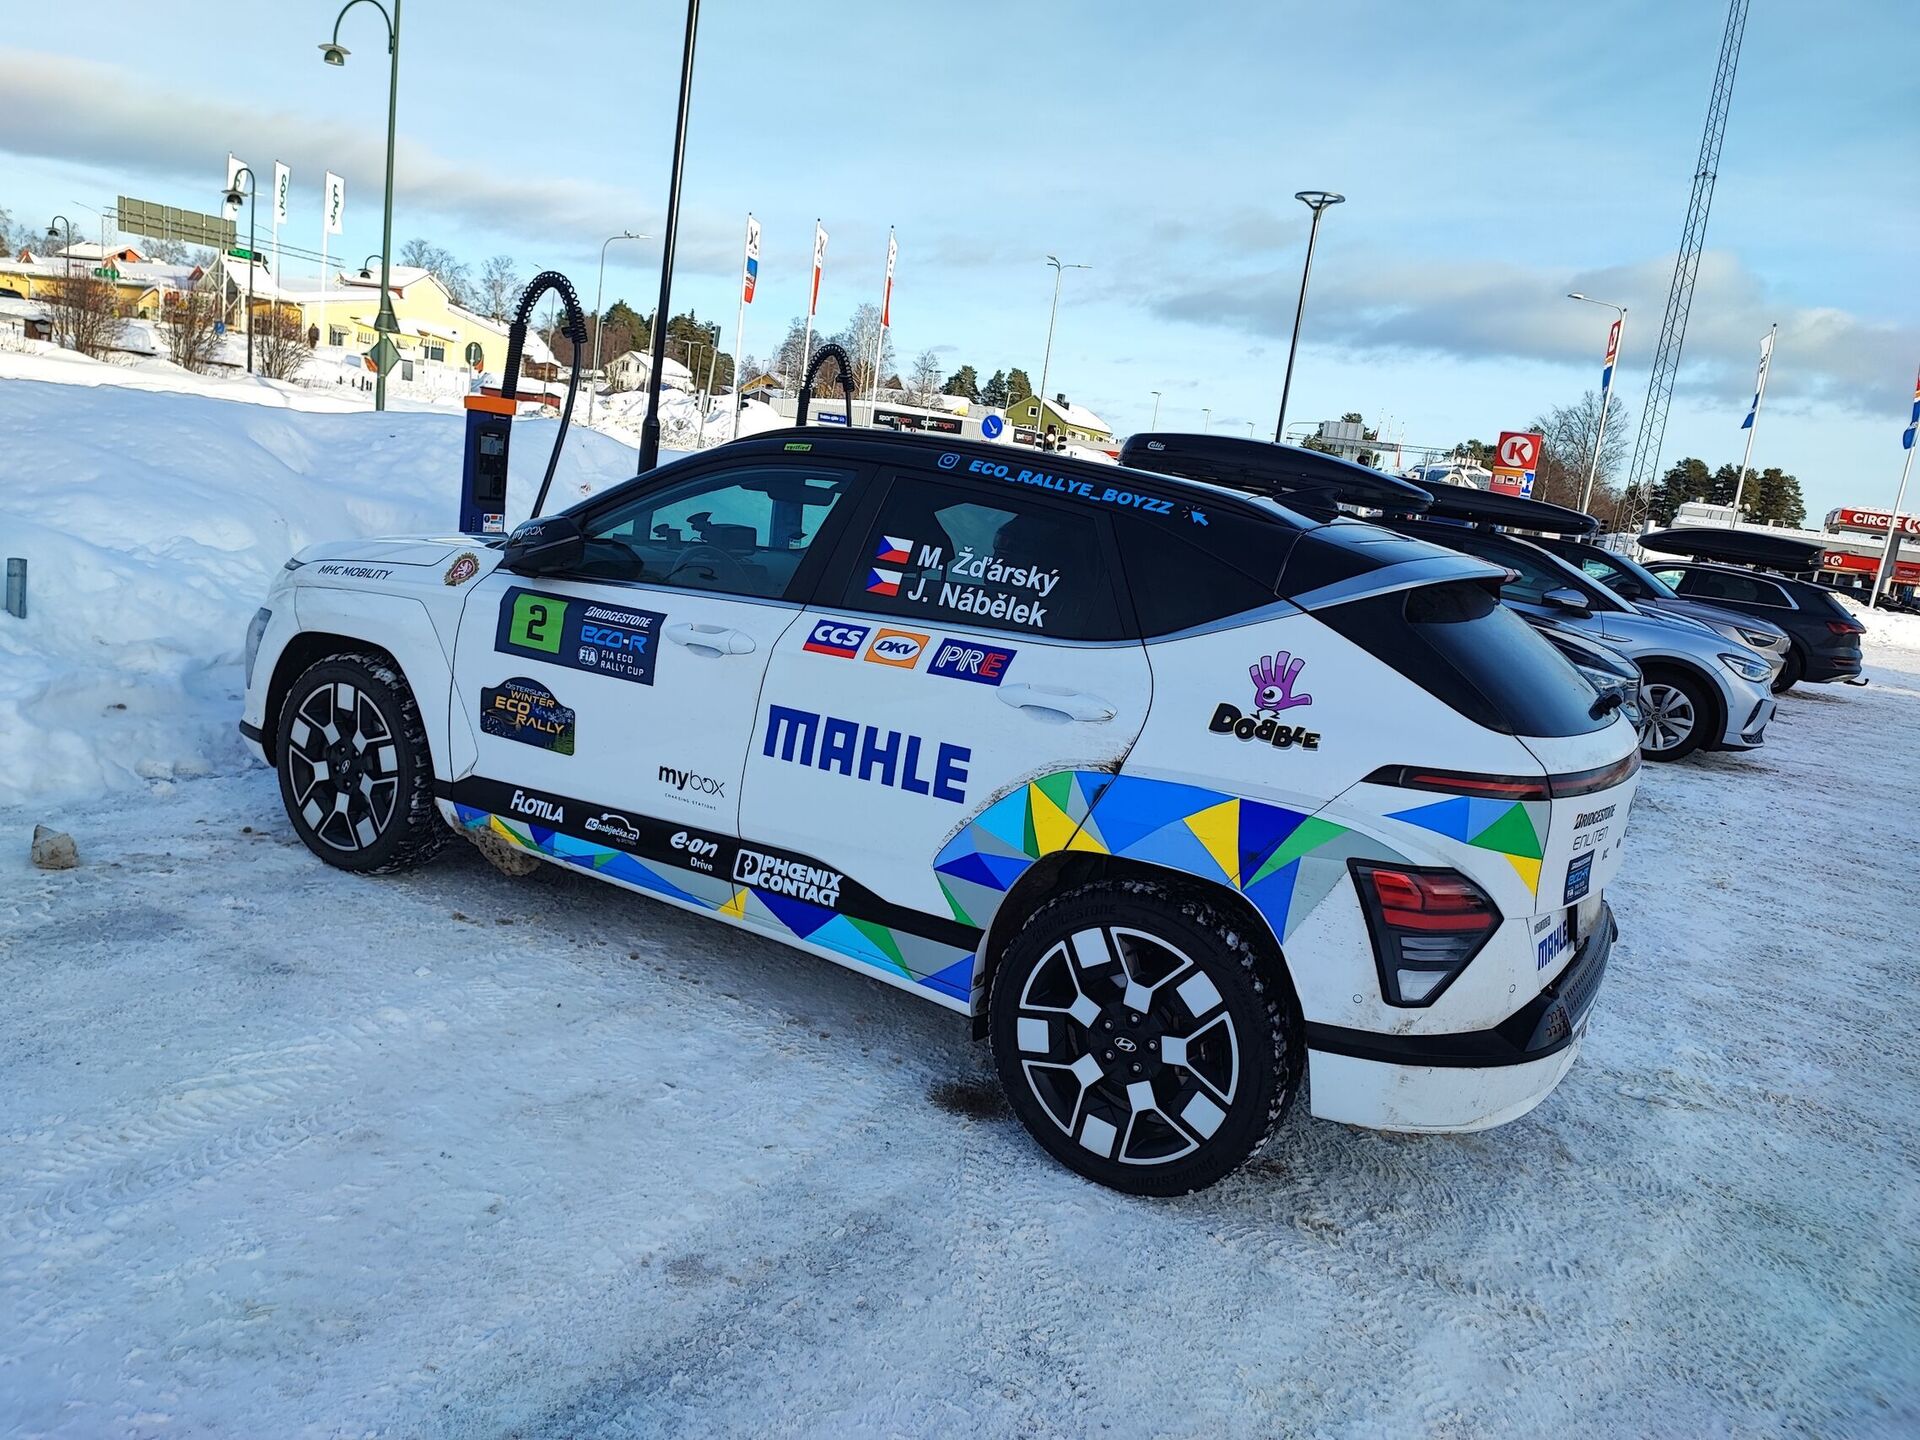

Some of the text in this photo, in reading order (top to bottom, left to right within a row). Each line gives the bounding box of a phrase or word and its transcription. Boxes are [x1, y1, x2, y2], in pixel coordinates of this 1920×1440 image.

[968, 459, 1175, 515] ECO_RALLYE_BOYZZ
[318, 565, 394, 580] MHC MOBILITY
[917, 545, 1060, 598] M. Žďárský
[907, 578, 1048, 627] J. Nábělek
[526, 605, 547, 641] 2
[584, 606, 653, 628] BRIDGESTONE
[814, 625, 864, 647] CCS
[875, 640, 918, 655] DKV
[600, 661, 644, 676] RALLY CUP
[601, 650, 633, 664] FIA ECO
[935, 645, 1008, 678] PRE
[505, 682, 550, 699] ÖSTERSUND
[511, 690, 555, 708] WINTER
[495, 695, 530, 715] ECO
[516, 713, 564, 734] RALLY
[763, 704, 972, 804] MAHLE
[658, 765, 725, 798] mybox
[510, 789, 564, 823] FLOTILA
[1573, 803, 1616, 831] BRIDGESTONE
[690, 856, 713, 872] Drive
[758, 872, 840, 907] CONTACT
[1537, 919, 1568, 971] MAHLE
